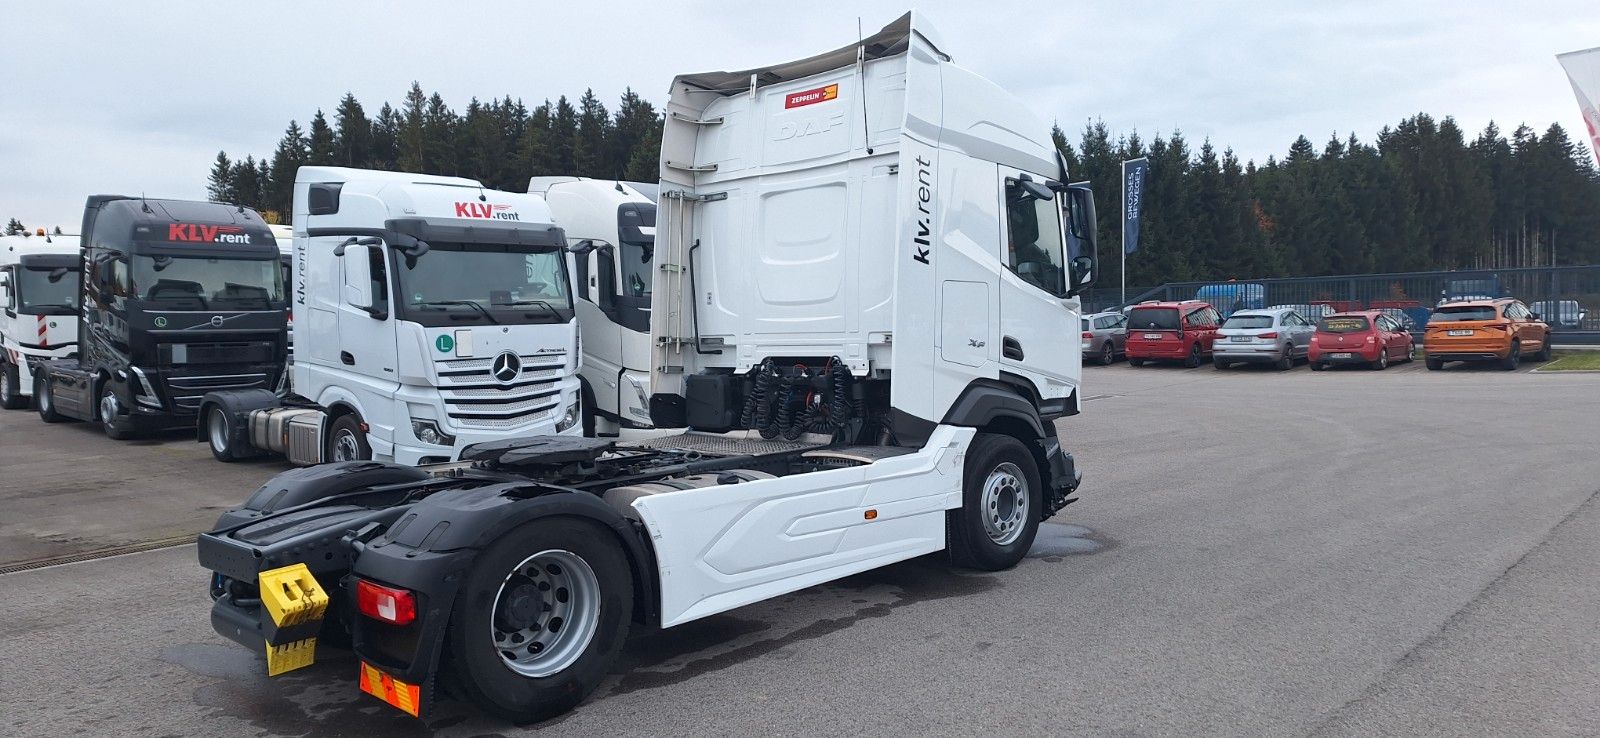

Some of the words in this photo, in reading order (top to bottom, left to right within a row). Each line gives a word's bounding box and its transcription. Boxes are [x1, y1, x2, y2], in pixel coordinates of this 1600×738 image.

[791, 93, 820, 104] ZEPPELIN
[913, 154, 931, 265] klv.rent
[297, 245, 305, 305] klv.rent
[440, 337, 450, 350] L
